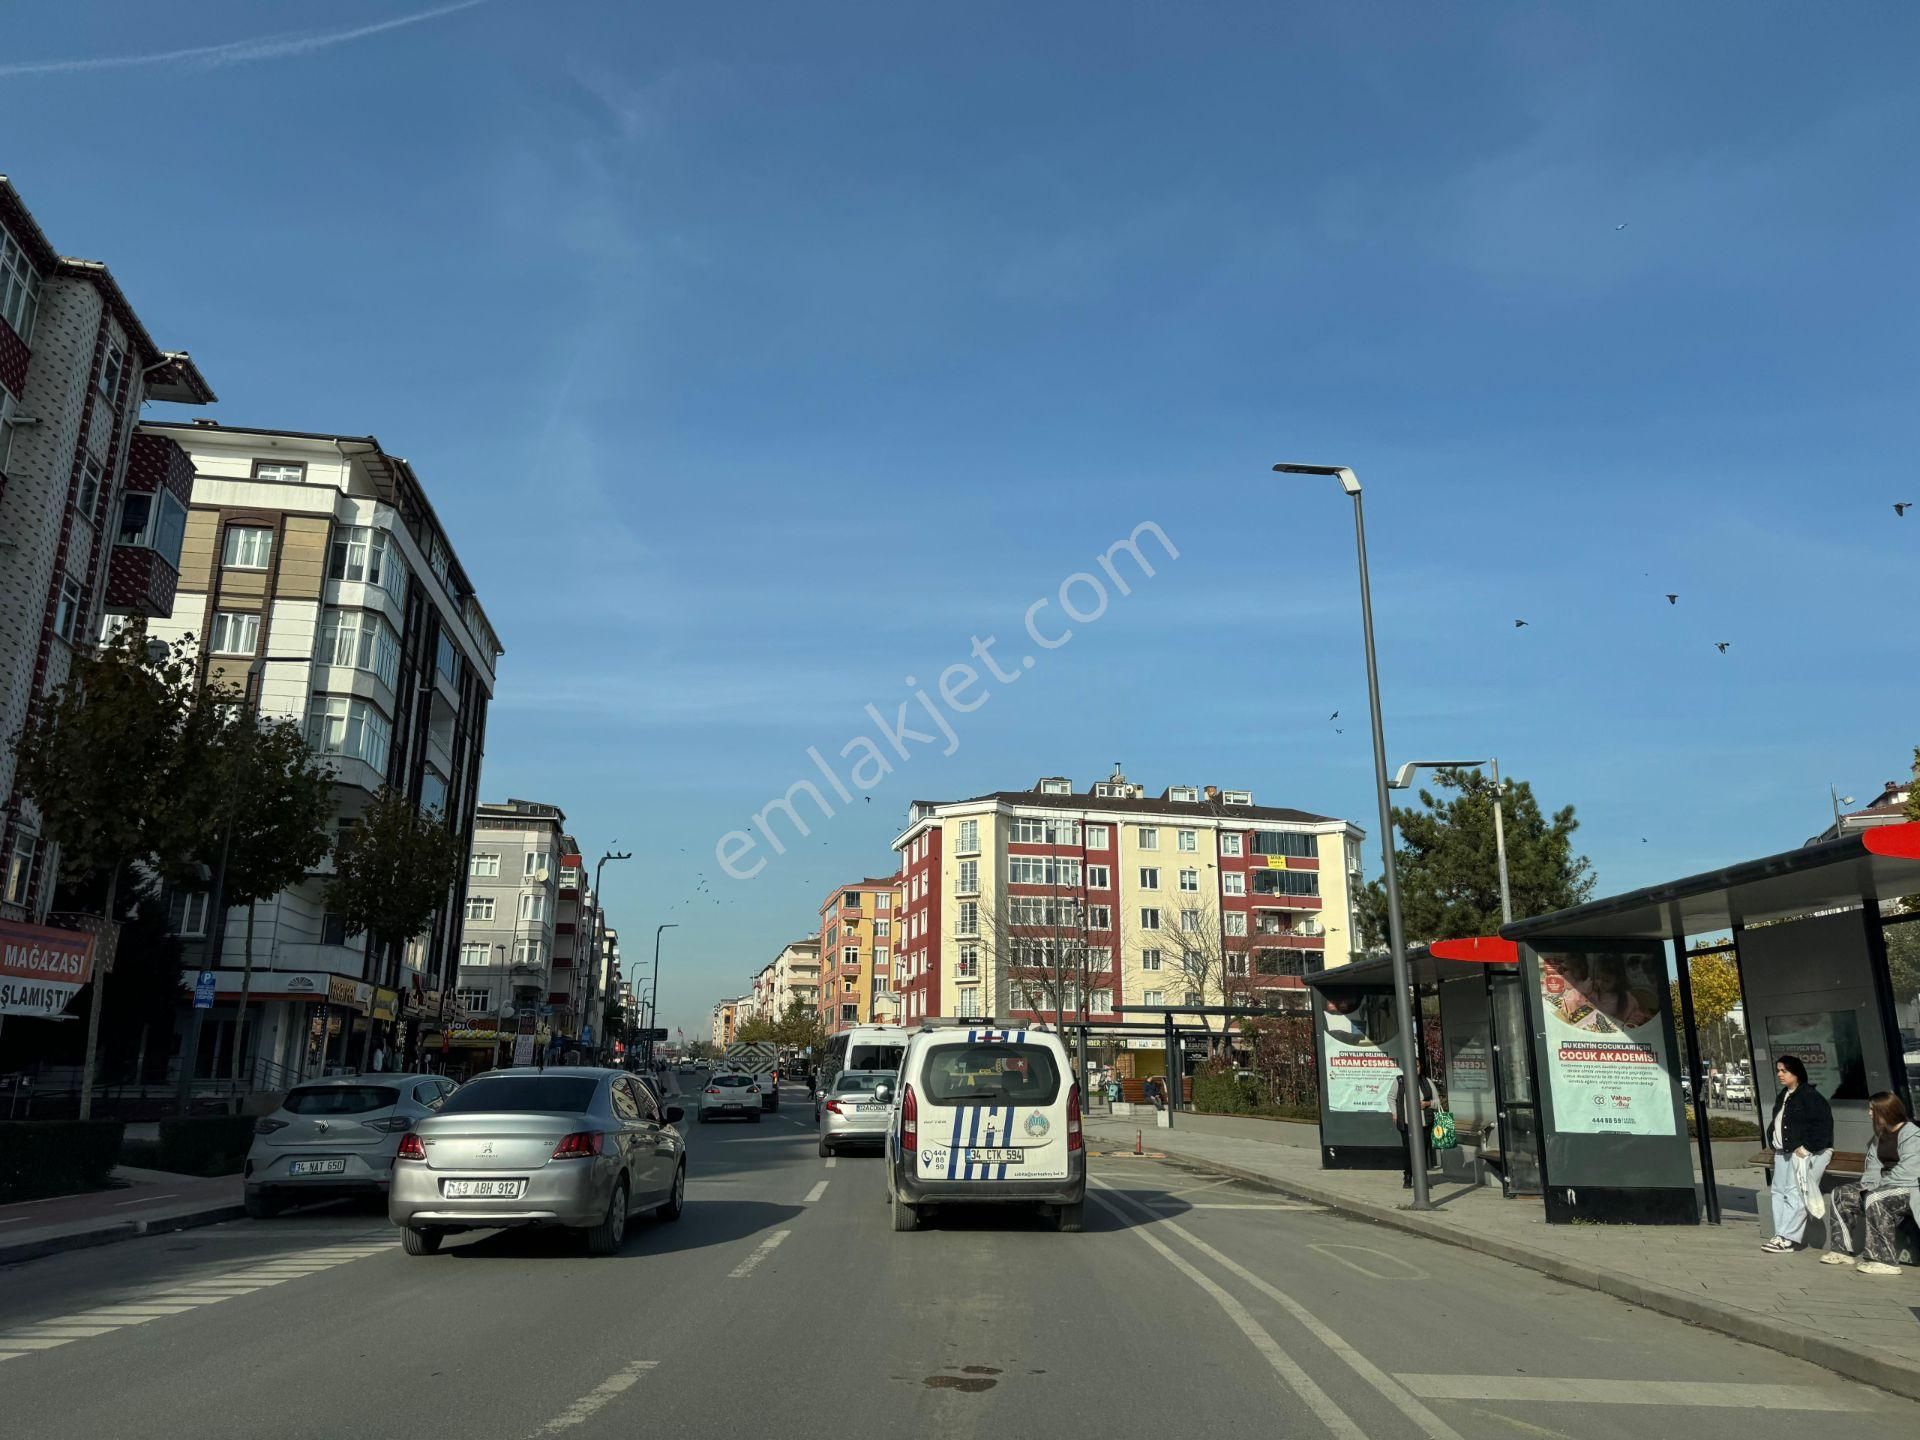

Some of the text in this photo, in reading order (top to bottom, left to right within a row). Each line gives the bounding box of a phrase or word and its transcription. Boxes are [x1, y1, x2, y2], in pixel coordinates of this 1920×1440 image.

[4, 944, 85, 975] MAĞAZASI
[1332, 1057, 1360, 1067] İKRAM
[1559, 1051, 1657, 1063] ÇOCUK AKADEMİSİ
[971, 1150, 1022, 1160] 34 CTK 594
[296, 1161, 342, 1172] 34 NAT 650
[474, 1182, 493, 1194] ABH
[498, 1182, 515, 1194] 912
